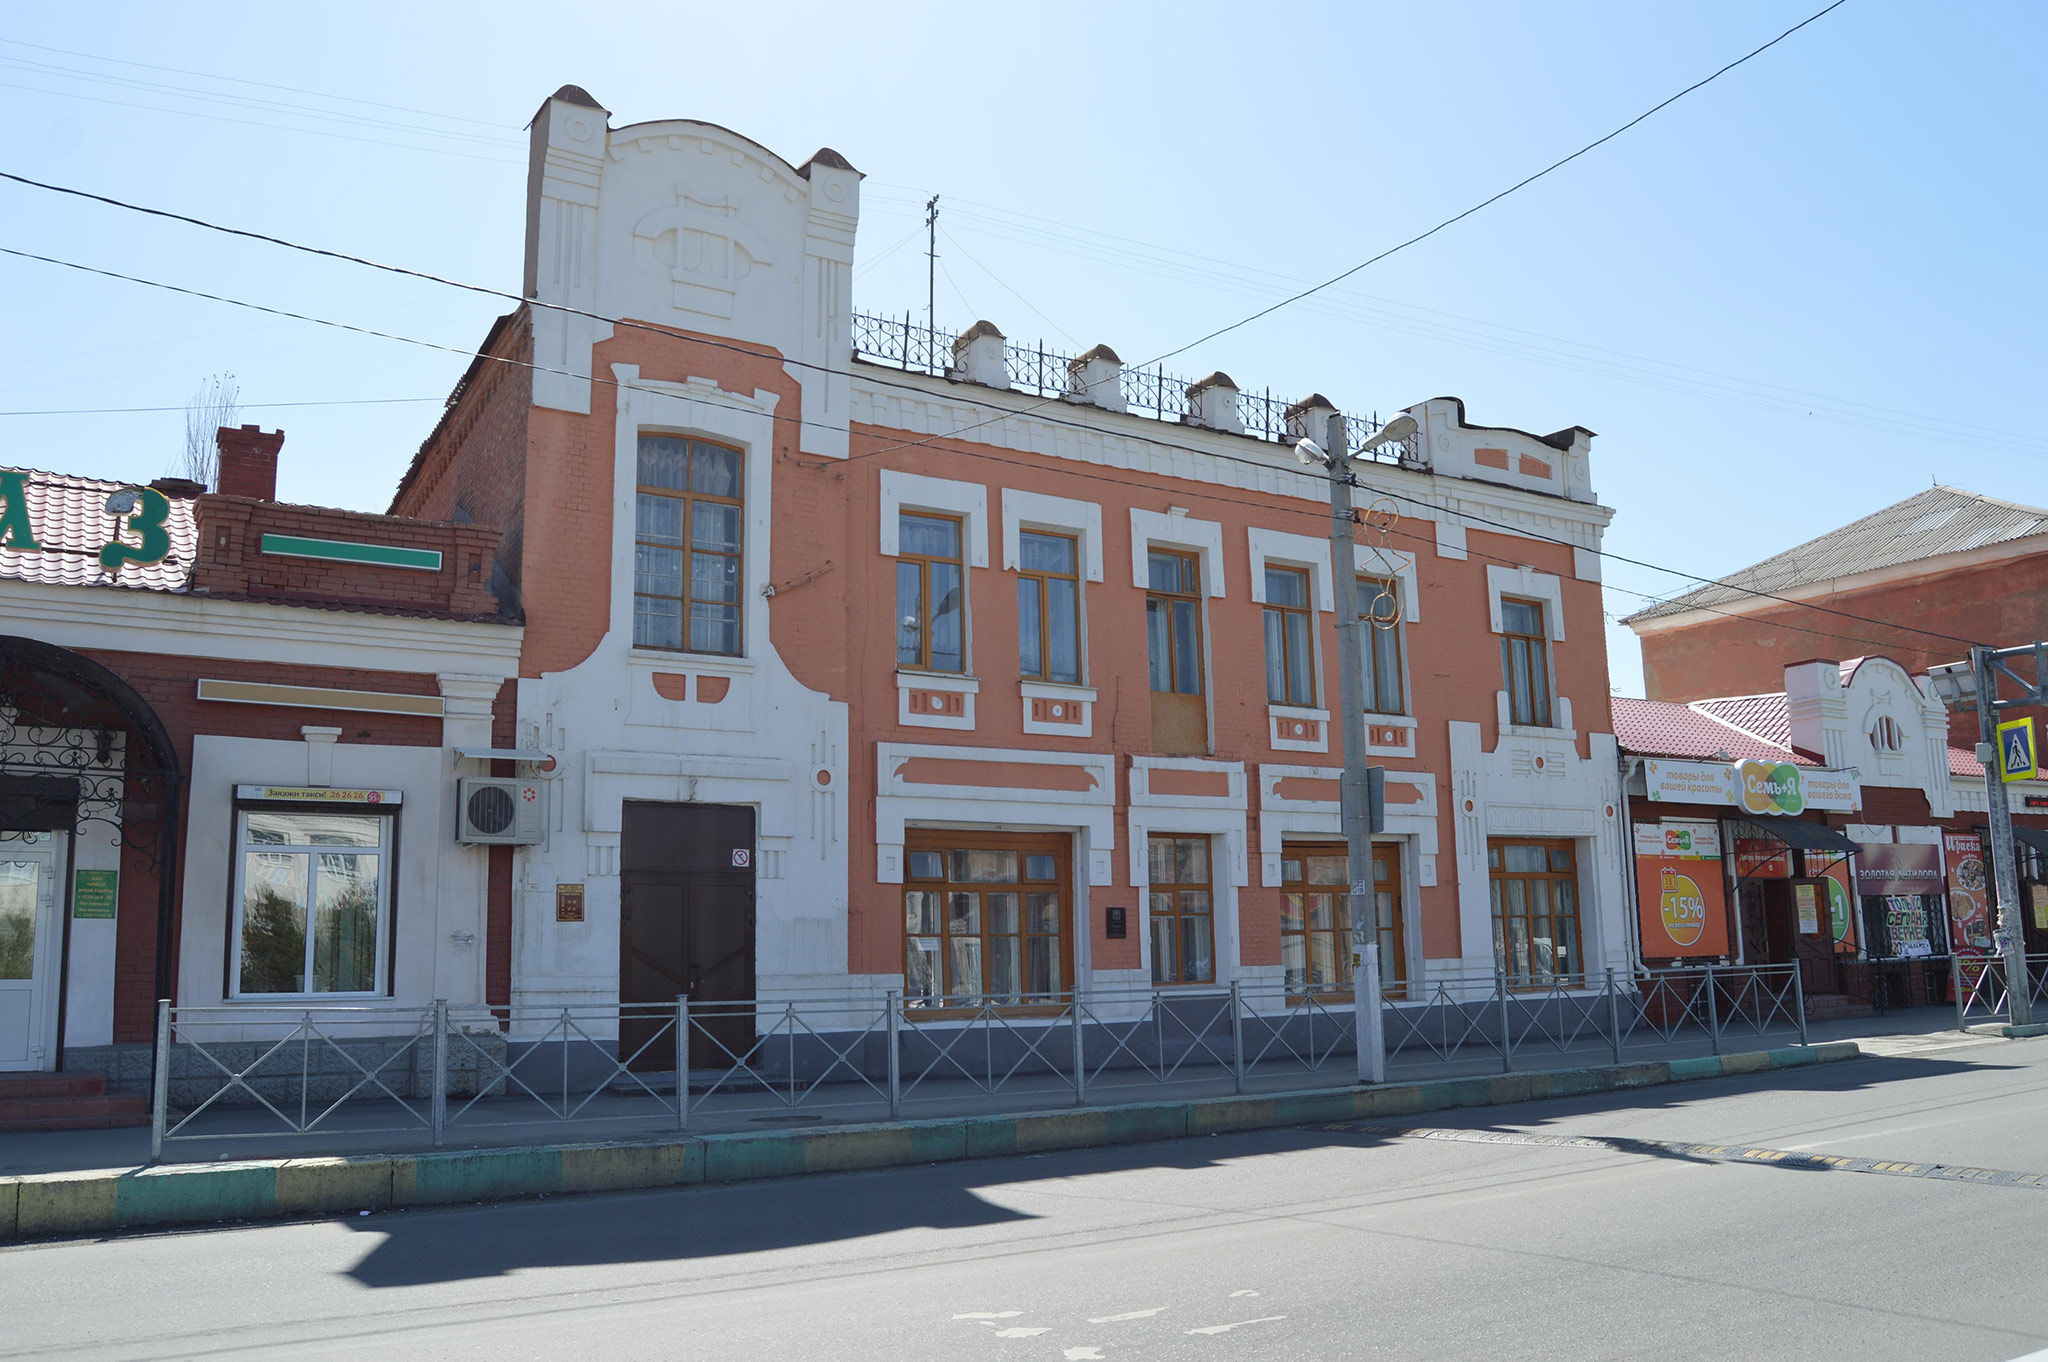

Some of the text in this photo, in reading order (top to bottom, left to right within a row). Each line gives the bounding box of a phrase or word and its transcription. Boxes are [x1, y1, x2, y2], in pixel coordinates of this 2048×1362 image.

[1666, 771, 1714, 781] товары для
[1660, 781, 1722, 793] вашей красоты
[1807, 779, 1849, 790] товары для
[267, 788, 299, 798] Закажи
[301, 790, 326, 798] такси!
[330, 791, 341, 799] 26
[1807, 791, 1833, 800] вашего
[1834, 790, 1852, 800] дома
[1860, 870, 1938, 881] ЗОЛОТАЯ АНТИЛОПА
[1663, 896, 1704, 919] -15%
